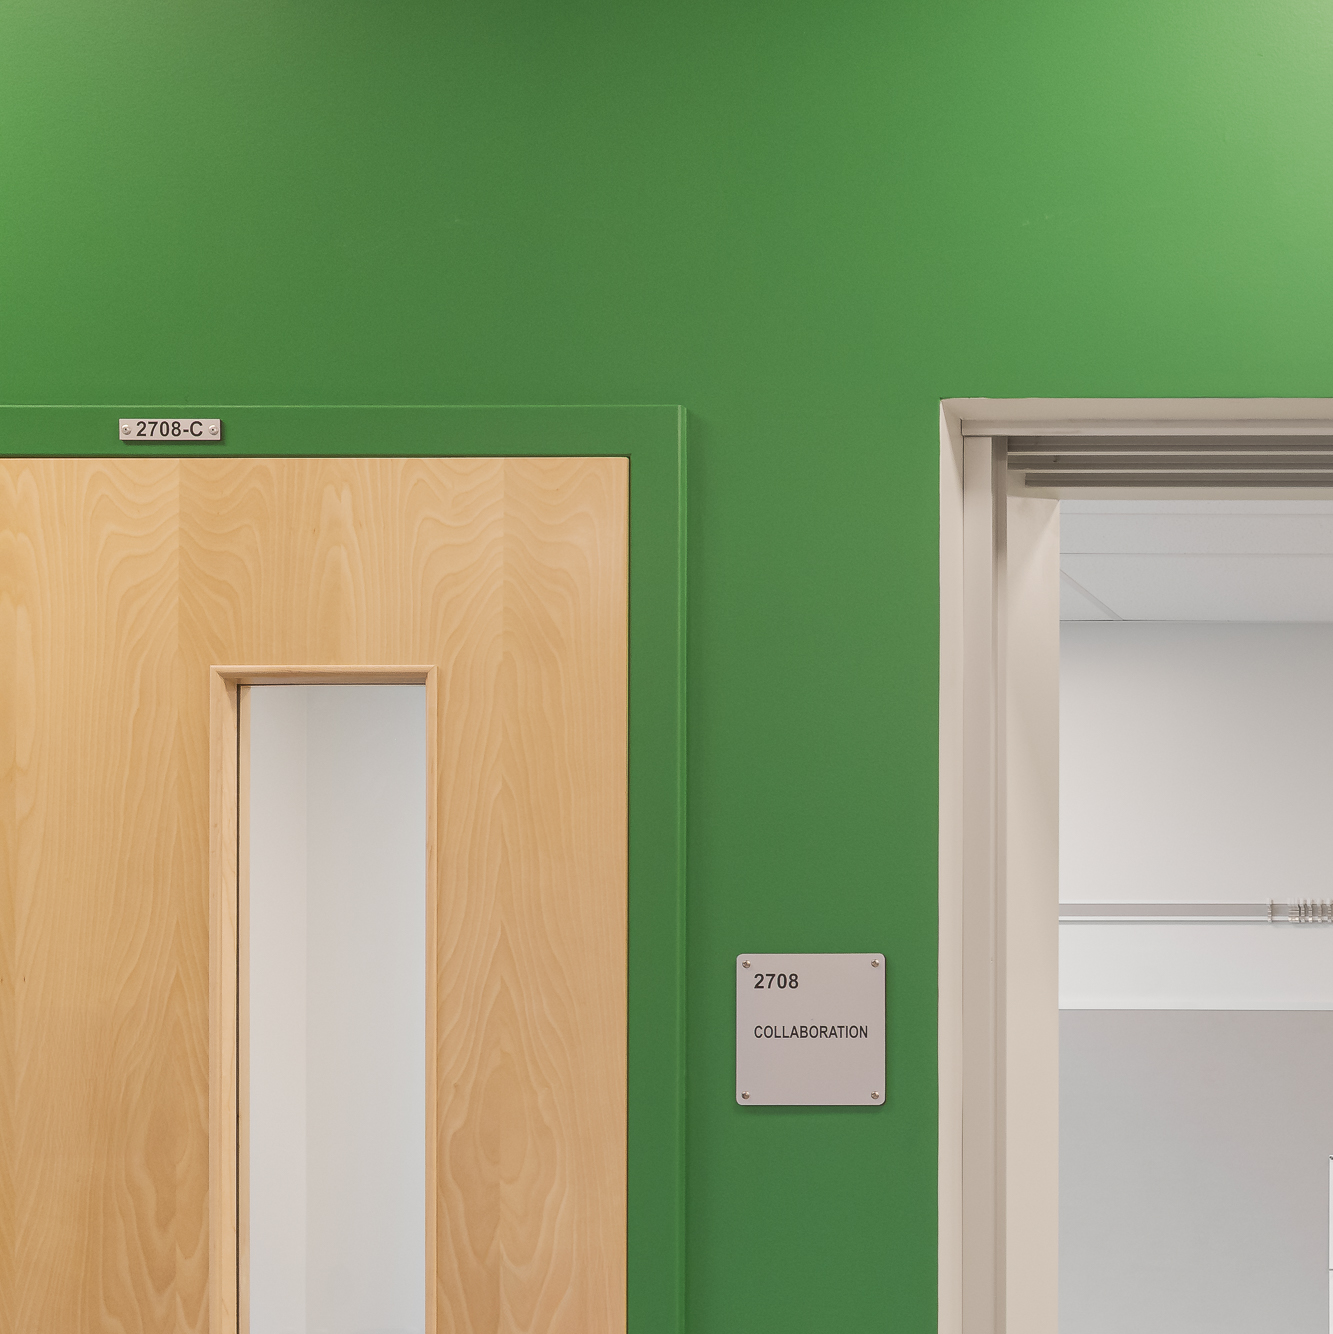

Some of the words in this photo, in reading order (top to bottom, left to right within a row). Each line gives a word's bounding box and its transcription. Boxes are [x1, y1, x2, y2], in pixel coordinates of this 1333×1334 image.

[137, 421, 202, 436] 2708-C
[754, 974, 798, 989] 2708
[755, 1026, 867, 1038] COLLABORATION
